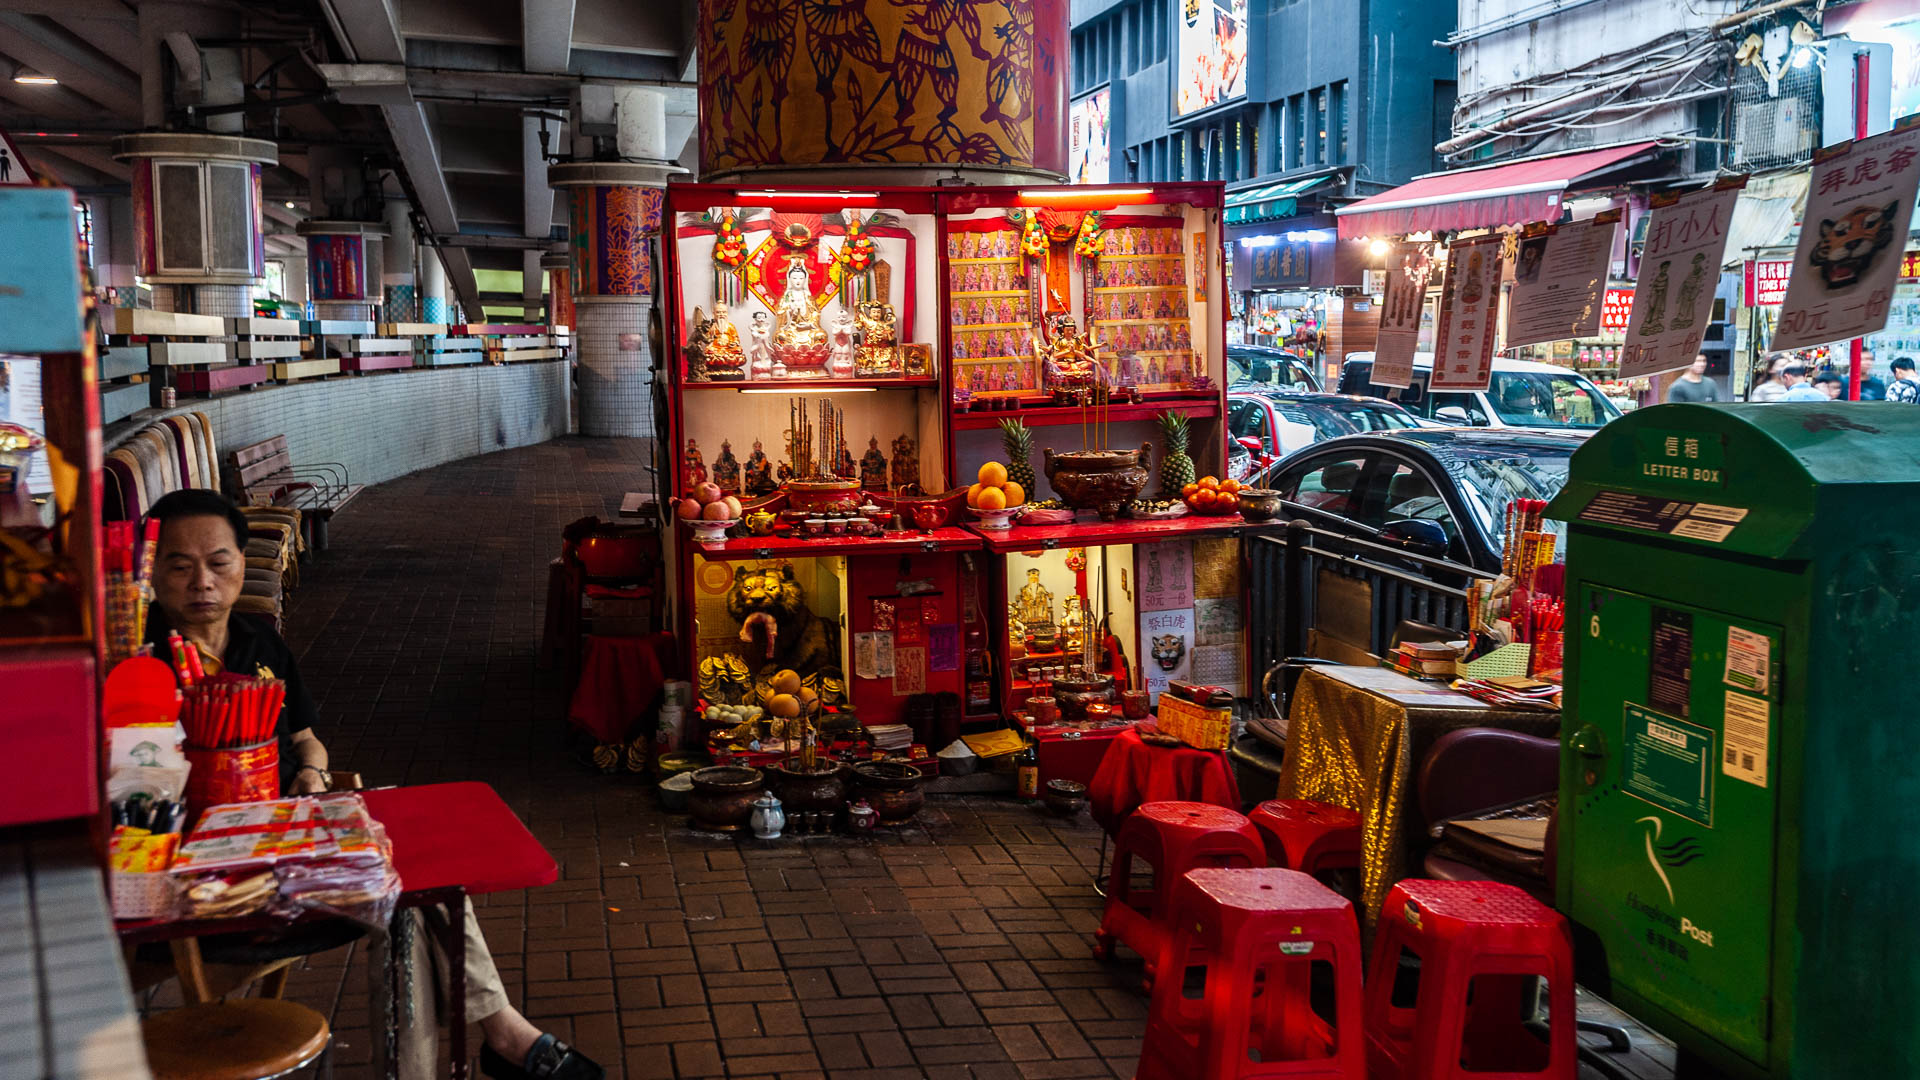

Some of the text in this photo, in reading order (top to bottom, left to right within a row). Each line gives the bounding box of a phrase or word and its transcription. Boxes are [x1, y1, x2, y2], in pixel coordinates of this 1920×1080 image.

[1817, 145, 1919, 196] 拜虎爺
[1651, 203, 1721, 254] 打小人
[1780, 288, 1889, 335] 50元 一份
[1624, 330, 1700, 365] 50元 一份
[1664, 436, 1699, 459] 信箱
[1643, 463, 1720, 483] LETTER BOX
[1145, 594, 1165, 607] 50元
[1590, 615, 1600, 638] 6
[1681, 916, 1715, 948] Post
